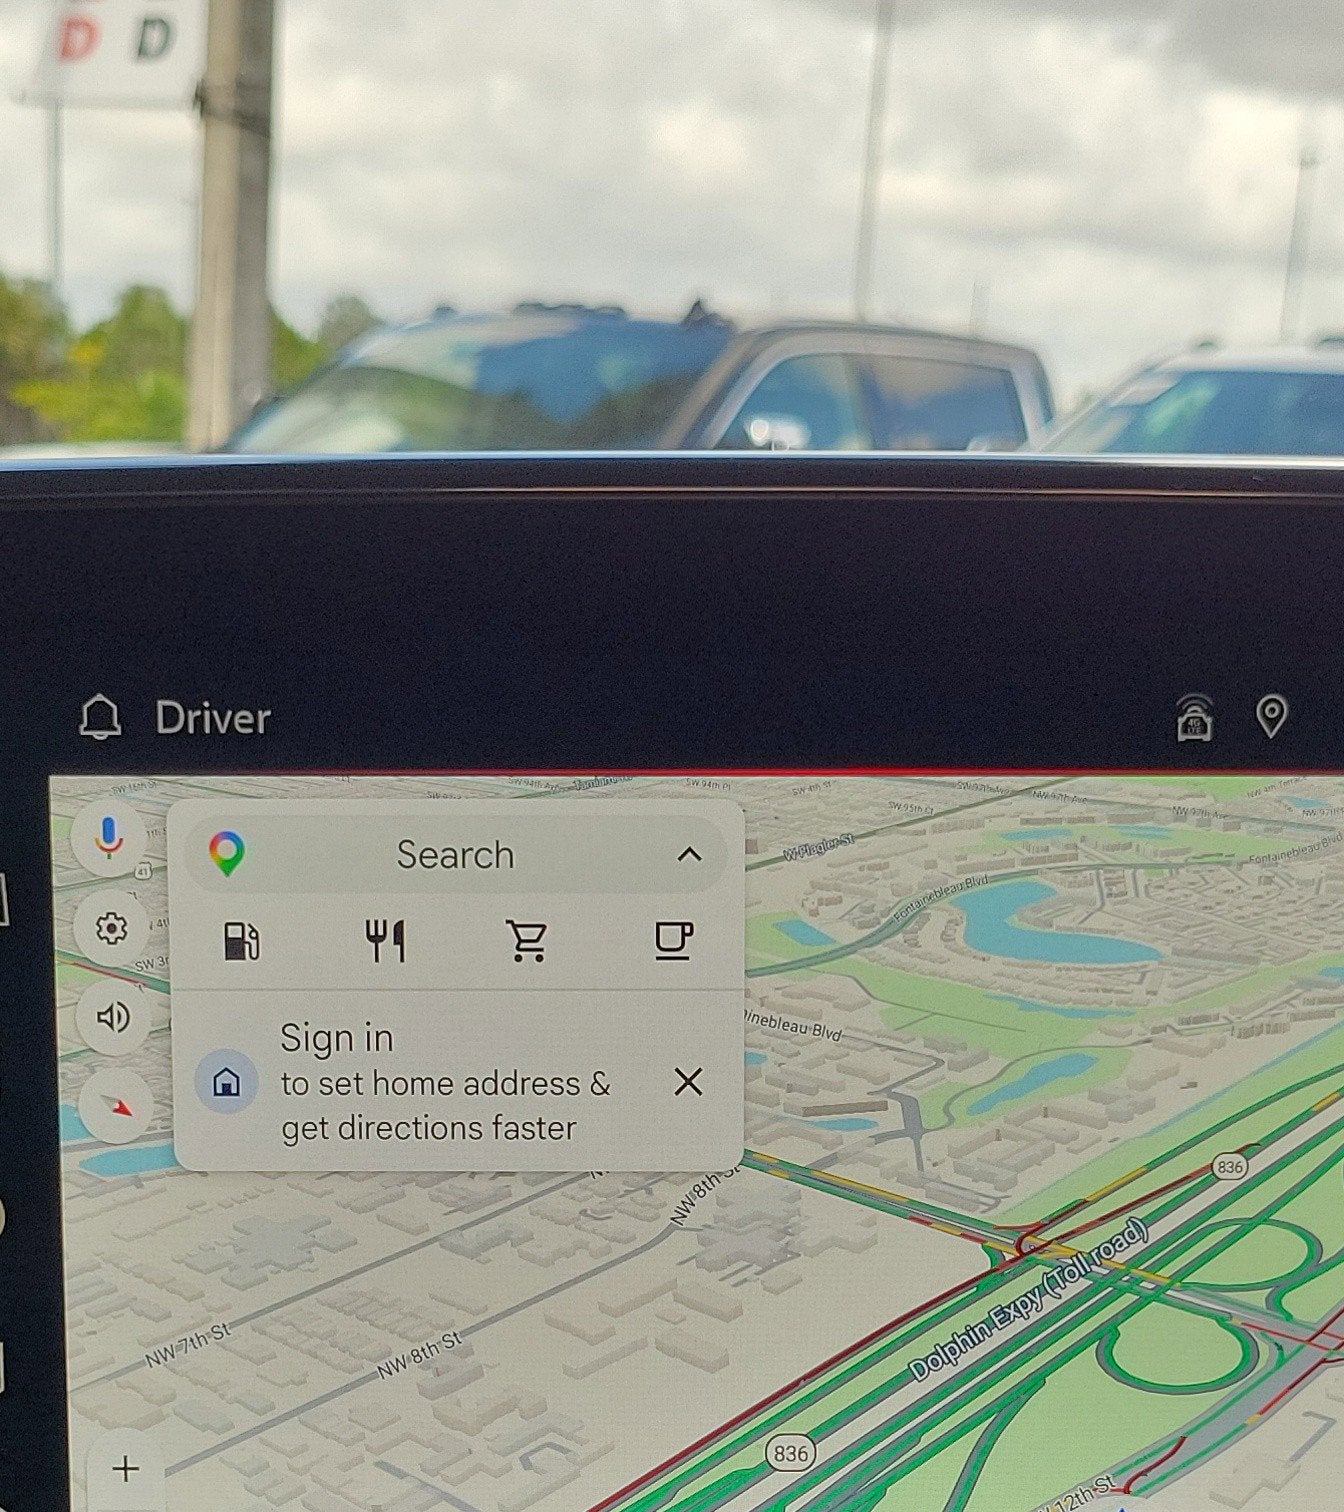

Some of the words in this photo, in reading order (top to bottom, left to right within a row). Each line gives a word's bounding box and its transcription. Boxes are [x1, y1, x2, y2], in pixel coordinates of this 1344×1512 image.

[157, 699, 272, 735] Driver
[397, 838, 515, 870] Search
[1249, 841, 1321, 864] Fontainebleau
[1321, 831, 1344, 849] Blvd
[893, 881, 964, 922] Fontainebleau
[964, 873, 990, 890] Blvd
[135, 958, 155, 972] SW
[280, 1021, 354, 1061] Sign
[365, 1021, 394, 1052] in
[812, 1023, 843, 1042] Blvd
[281, 1072, 310, 1097] to
[319, 1072, 364, 1097] set
[373, 1069, 455, 1097] home
[463, 1069, 581, 1097] address
[589, 1070, 612, 1097] &
[282, 1116, 330, 1148] get
[338, 1113, 484, 1141] directions
[492, 1113, 578, 1141] faster
[1217, 1160, 1244, 1174] 836
[669, 1193, 696, 1227] NW
[692, 1172, 722, 1199] 8th
[908, 1321, 994, 1383] Dolphin
[988, 1288, 1044, 1331] Expy
[1042, 1253, 1092, 1299] (Toll
[1091, 1216, 1148, 1267] road)
[145, 1343, 177, 1369] NW
[178, 1332, 209, 1355] 7th
[210, 1322, 232, 1341] St
[377, 1354, 408, 1380] NW
[409, 1341, 440, 1365] 8th
[441, 1331, 463, 1348] St
[773, 1445, 809, 1463] 836
[1094, 1474, 1116, 1494] St
